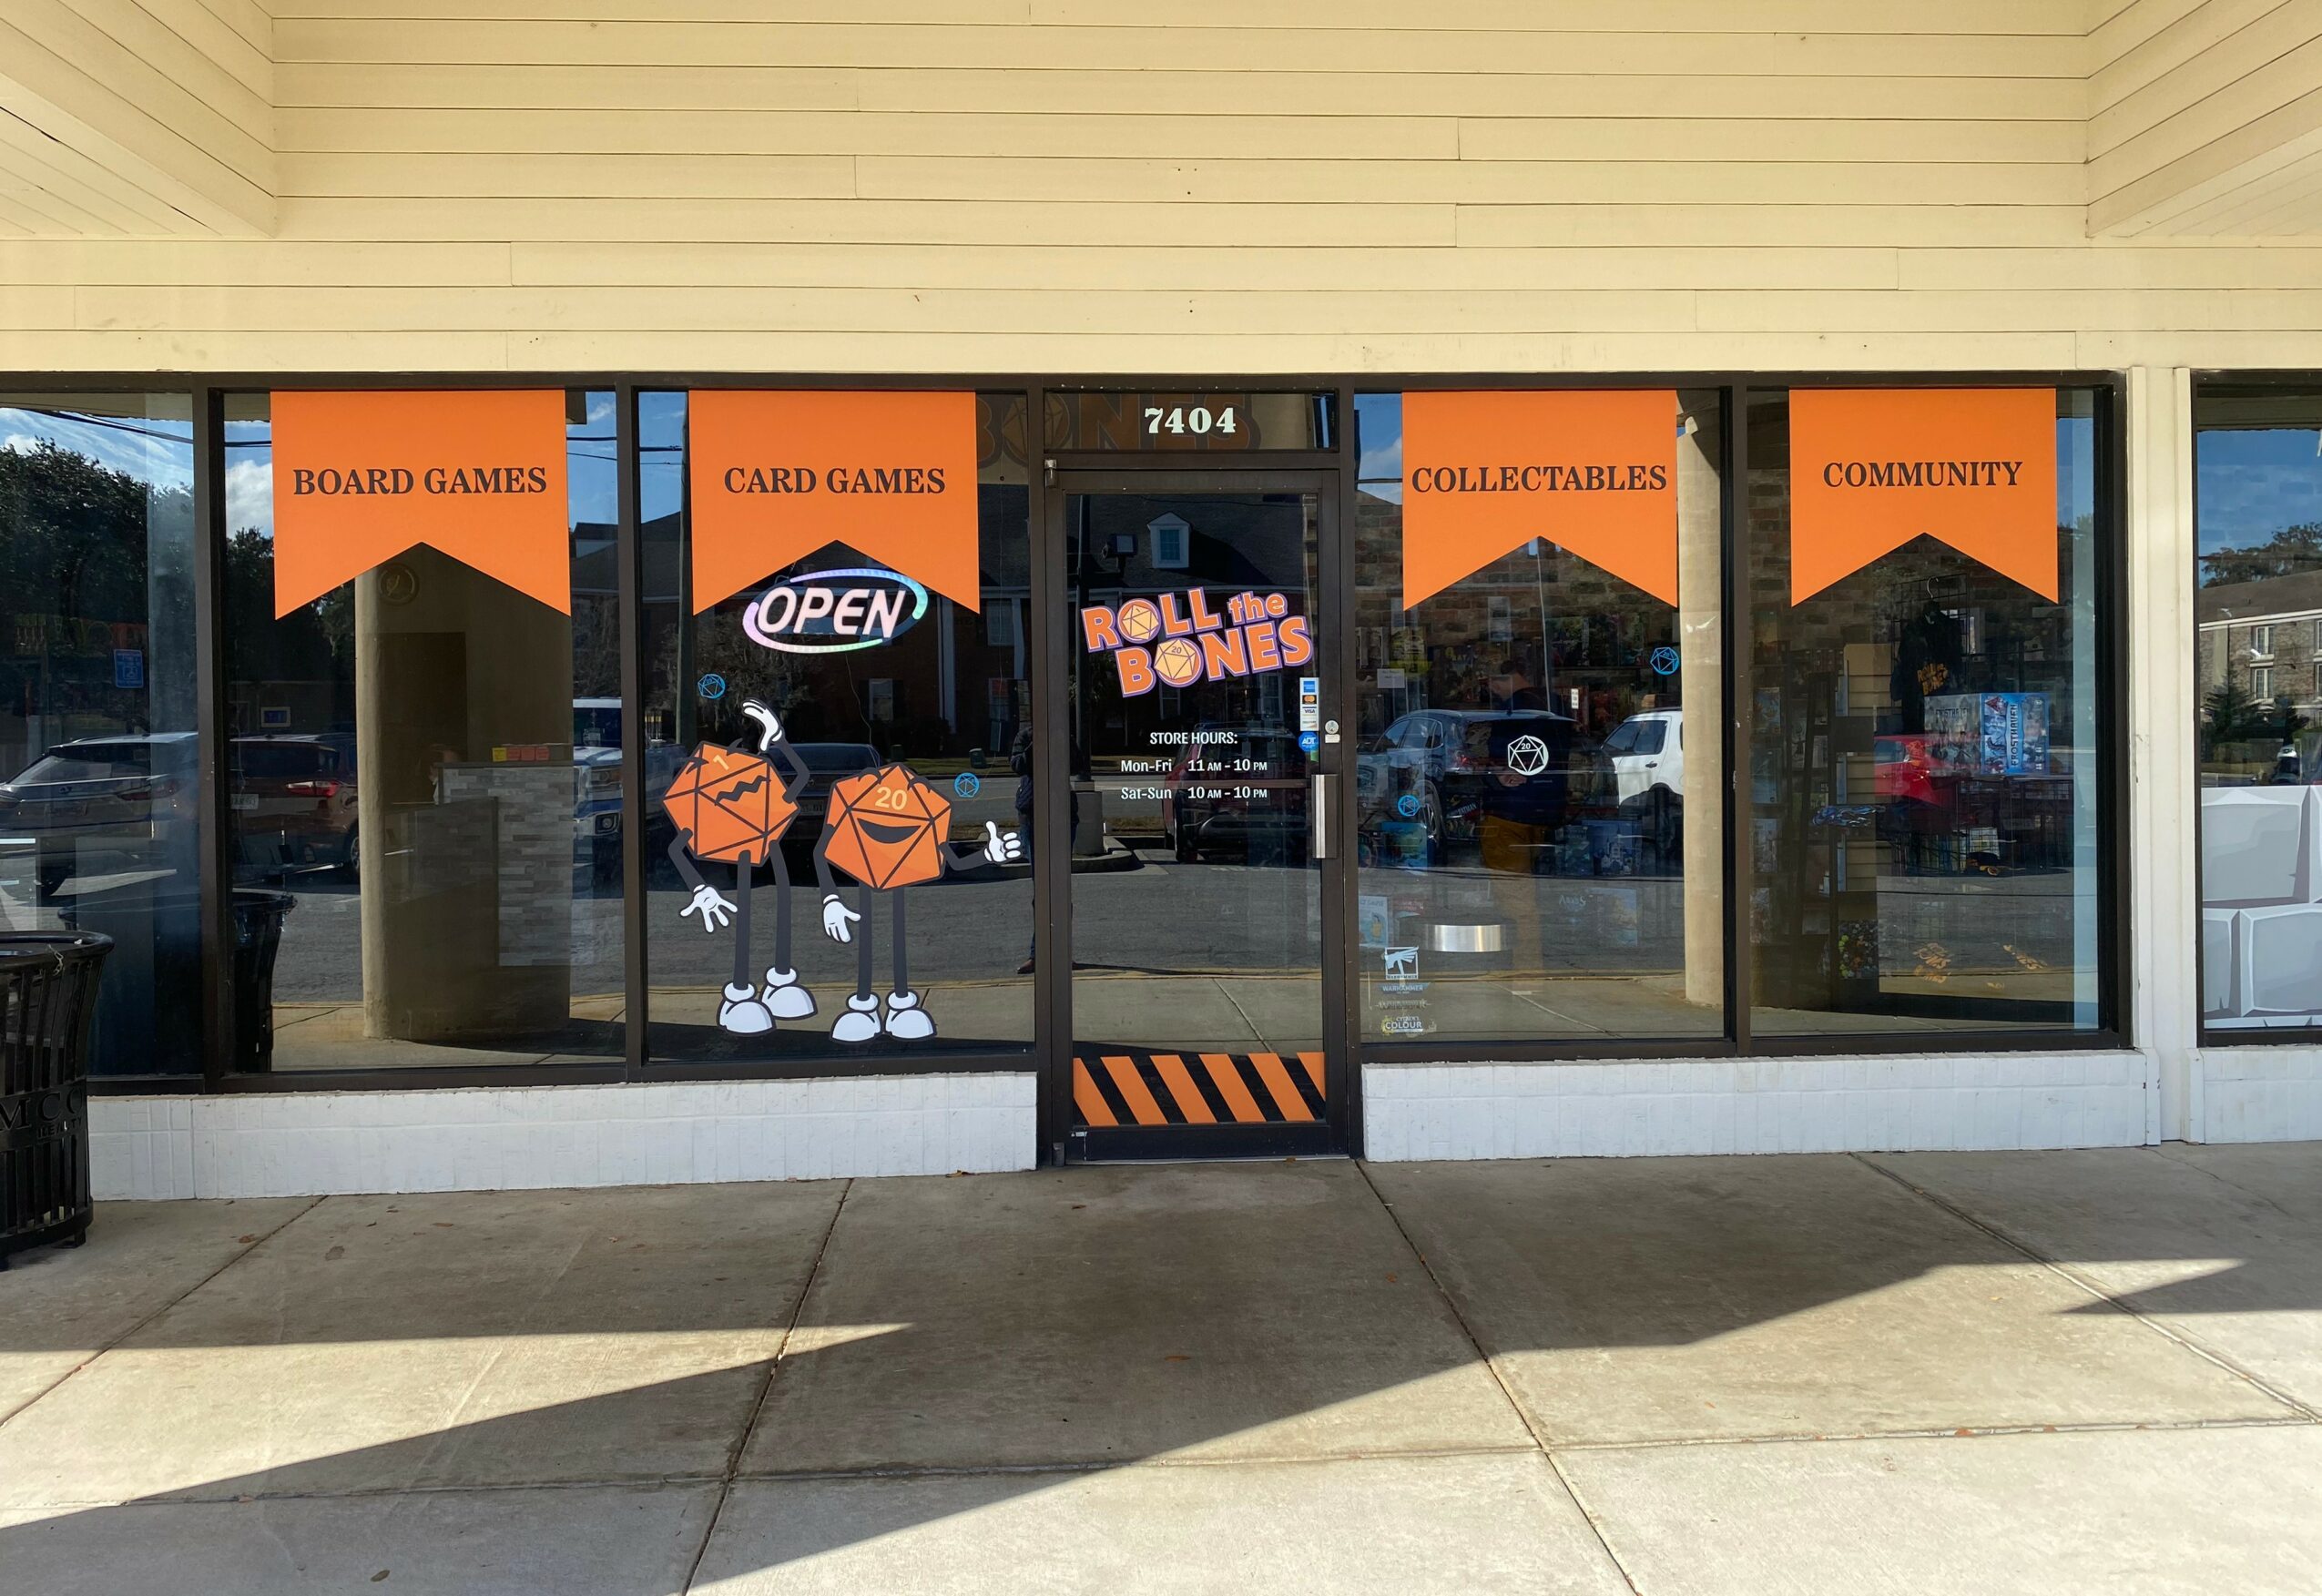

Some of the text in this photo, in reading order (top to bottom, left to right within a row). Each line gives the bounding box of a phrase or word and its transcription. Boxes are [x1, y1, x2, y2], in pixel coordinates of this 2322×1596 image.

[1145, 407, 1237, 434] 7404
[294, 467, 547, 496] BOARD GAMES
[725, 467, 946, 494] CARD GAMES
[1412, 465, 1667, 493] COLLECTABLES
[1824, 461, 2023, 488] COMMUNITY
[758, 586, 907, 638] OPEN
[1082, 587, 1288, 652] ROLL the
[1115, 616, 1312, 696] BONES
[1150, 731, 1238, 745] STORE HOURS:
[1301, 737, 1316, 745] ADT
[1521, 742, 1532, 750] 20
[2011, 704, 2019, 768] FROSTHAVEN
[712, 754, 730, 772] 1
[1121, 759, 1172, 772] Mon-Fri
[1188, 759, 1205, 772] 11
[1207, 762, 1222, 772] AM
[1234, 758, 1251, 772] 10
[1254, 761, 1268, 771] PM
[875, 786, 908, 811] 20
[1121, 787, 1173, 799] Sat-Sun
[1188, 787, 1206, 799] 10
[1207, 789, 1222, 798] AM
[1234, 786, 1251, 798] 10
[1254, 788, 1268, 798] PM
[1385, 1021, 1422, 1030] COLOUR
